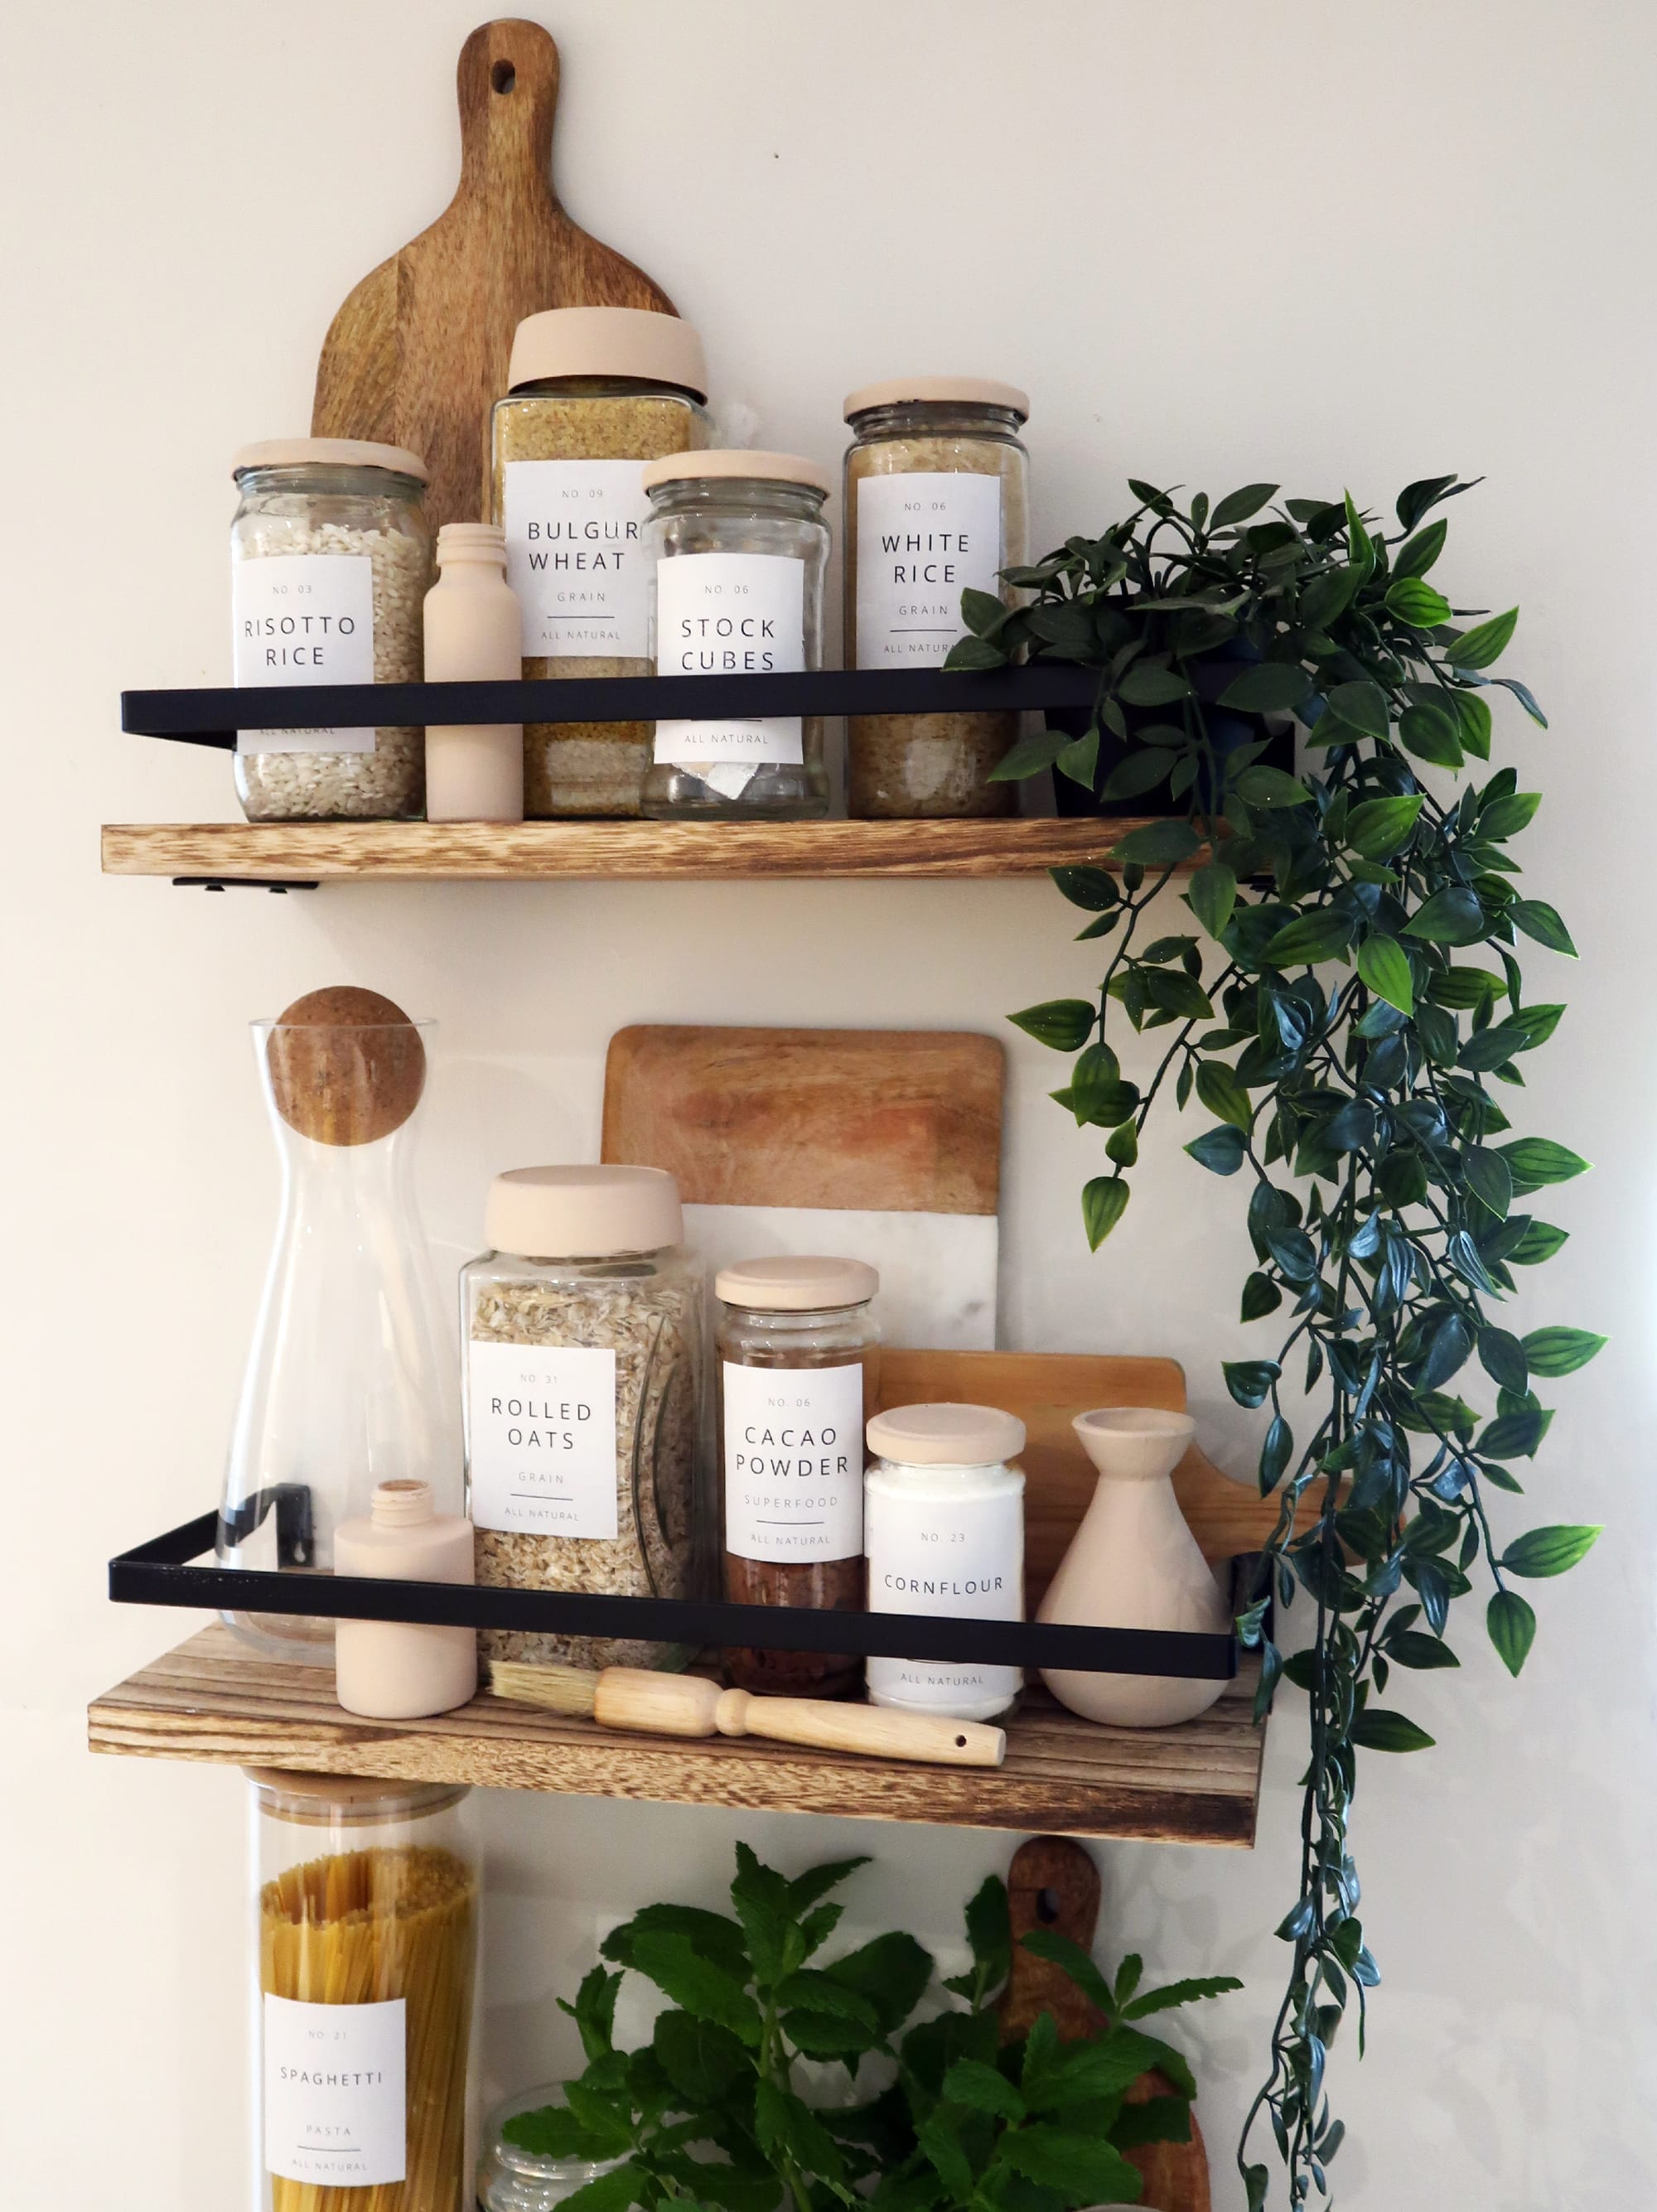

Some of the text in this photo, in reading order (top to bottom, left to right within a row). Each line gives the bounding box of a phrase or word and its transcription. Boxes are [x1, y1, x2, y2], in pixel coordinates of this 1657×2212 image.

[589, 490, 603, 498] 09
[931, 502, 947, 511] 06
[528, 521, 639, 540] BULGUR
[882, 534, 969, 553] WHITE
[528, 552, 626, 571] WHEAT
[894, 564, 955, 584] RICE
[297, 585, 312, 594] 03
[734, 585, 749, 595] 06
[557, 592, 606, 602] GRAIN
[899, 606, 948, 616] GRAIN
[244, 616, 355, 637] RISOTTO
[681, 618, 775, 639] STOCK
[540, 630, 621, 640] ALL NATURAL
[884, 645, 902, 654] ALL
[266, 647, 324, 667] RICE
[681, 650, 774, 671] CUBES
[684, 734, 769, 745] ALL NATURAL
[545, 1375, 558, 1384] 31
[491, 1398, 592, 1421] ROLLED
[796, 1398, 810, 1408] 06
[507, 1428, 573, 1450] OATS
[745, 1426, 837, 1447] CACAO
[736, 1453, 848, 1477] POWDER
[518, 1471, 564, 1484] GRAIN
[744, 1495, 838, 1509] SUPERFOOD
[504, 1507, 579, 1522] ALL NATURAL
[751, 1533, 831, 1546] ALL NATURAL
[950, 1533, 965, 1543] 23
[884, 1574, 1002, 1596] CORNFLOUR
[900, 1673, 983, 1686] ALL NATURAL
[280, 2066, 383, 2087] SPAGHETTI
[306, 2124, 351, 2137] PASTA
[292, 2158, 369, 2172] ALL NATURAL
